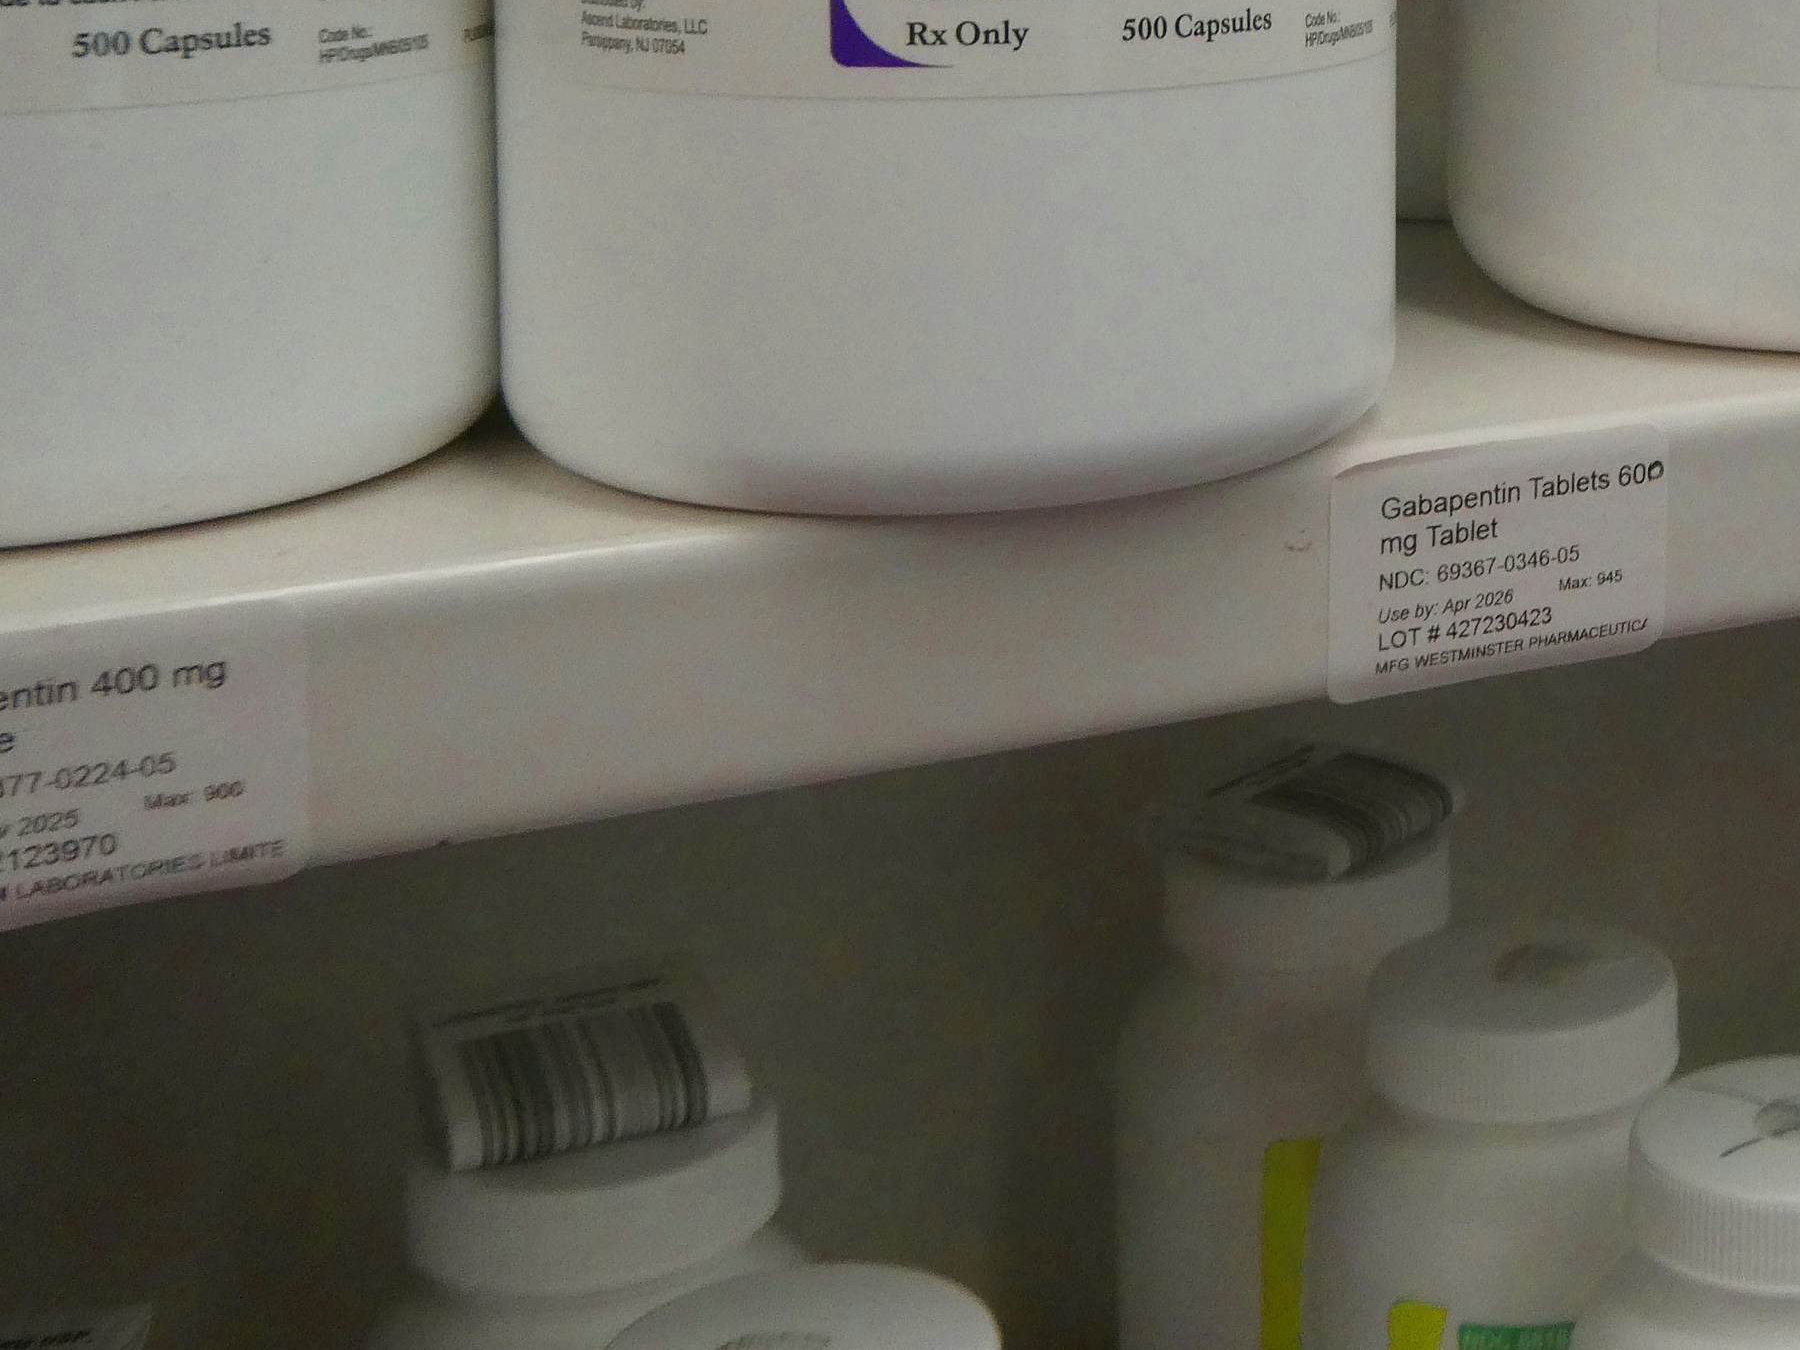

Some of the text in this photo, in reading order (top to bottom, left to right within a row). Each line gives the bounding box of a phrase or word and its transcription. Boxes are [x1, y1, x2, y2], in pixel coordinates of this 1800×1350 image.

[71, 21, 272, 60] 500 Capsules
[684, 18, 709, 35] LLC
[906, 19, 1031, 52] Rx Only
[1121, 7, 1274, 44] 500 Capsules
[1380, 459, 1666, 521] Gabapentin Tablets 600
[1380, 517, 1499, 557] mg Tablet
[1378, 543, 1581, 592] NDC: 69367-0346-05
[1378, 568, 1624, 625] Use Apr 2026 Max: 945
[1378, 605, 1554, 652] LOT 427230423
[1374, 656, 1410, 675] MFG
[1414, 638, 1525, 669] WESTMINSTER
[89, 659, 228, 697] 400 mg
